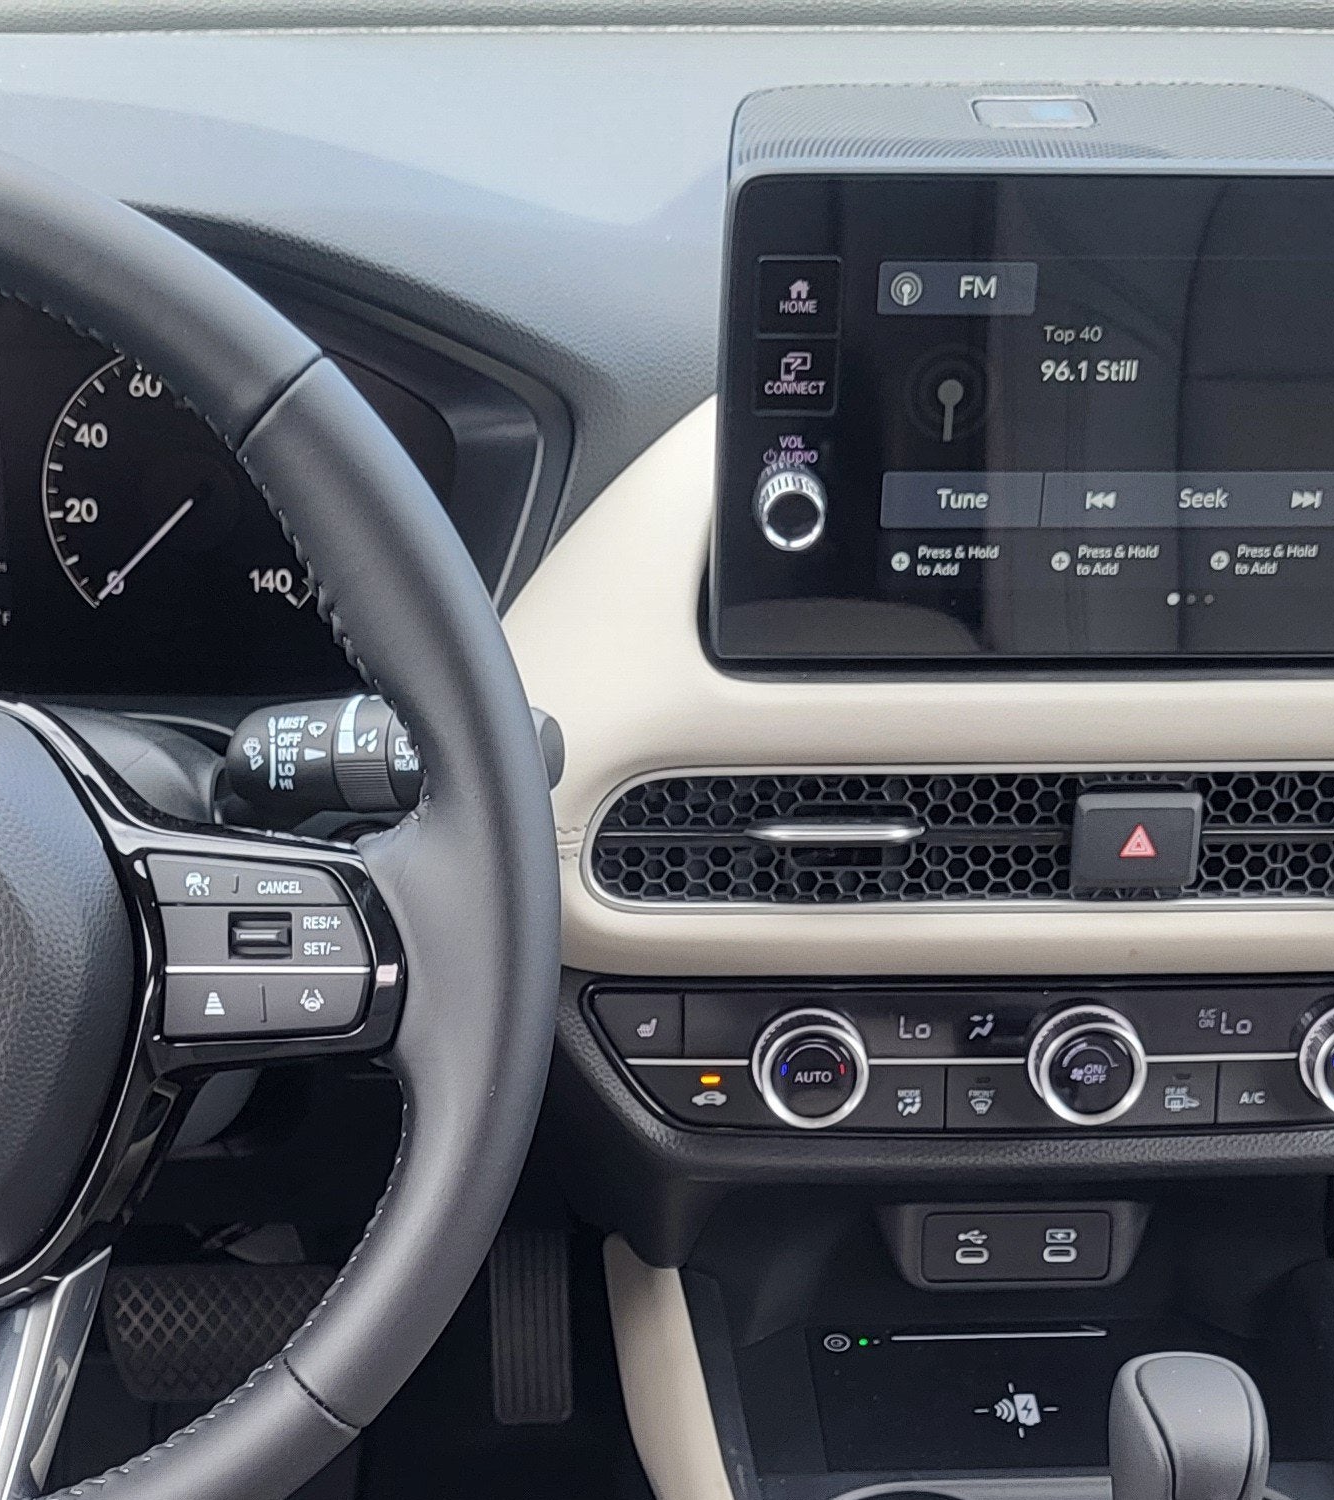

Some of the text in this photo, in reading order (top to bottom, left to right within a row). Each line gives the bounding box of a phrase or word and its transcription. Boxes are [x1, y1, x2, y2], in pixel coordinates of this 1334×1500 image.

[959, 275, 998, 300] FM
[779, 300, 817, 314] HOME
[1043, 325, 1103, 345] Top 40
[1040, 359, 1139, 383] 96.1 Still
[128, 372, 163, 398] 60
[764, 381, 826, 396] CONNECT
[74, 422, 108, 449] 40
[779, 435, 806, 449] VOL
[778, 450, 818, 464] AUDIO
[936, 488, 989, 510] Tune
[1178, 487, 1229, 509] Seek
[64, 497, 99, 523] 20
[917, 545, 1000, 560] Press & Hold
[1077, 545, 1160, 559] Press & Hold
[1236, 544, 1319, 558] Press & Hold
[916, 562, 960, 576] to Add
[1076, 562, 1119, 576] to Add
[1234, 561, 1278, 575] to Add
[248, 568, 293, 594] 140
[278, 715, 309, 731] MIST
[277, 732, 303, 747] OFF
[277, 747, 300, 762] INT
[277, 763, 296, 777] LO
[279, 778, 294, 790] HI
[257, 880, 303, 895] CANCEL
[302, 915, 342, 931] RES/+
[303, 941, 342, 956] SET/-
[1198, 1008, 1217, 1019] A/C
[898, 1015, 932, 1040] Lo
[1198, 1018, 1216, 1029] ON
[1220, 1011, 1253, 1036] Lo
[794, 1070, 833, 1084] AUTO
[1084, 1064, 1108, 1075] ON/
[1083, 1074, 1107, 1085] OFF
[897, 1089, 921, 1098] MODE
[968, 1089, 996, 1098] FRONT
[1165, 1087, 1189, 1096] REAR
[1238, 1090, 1266, 1105] A/C
